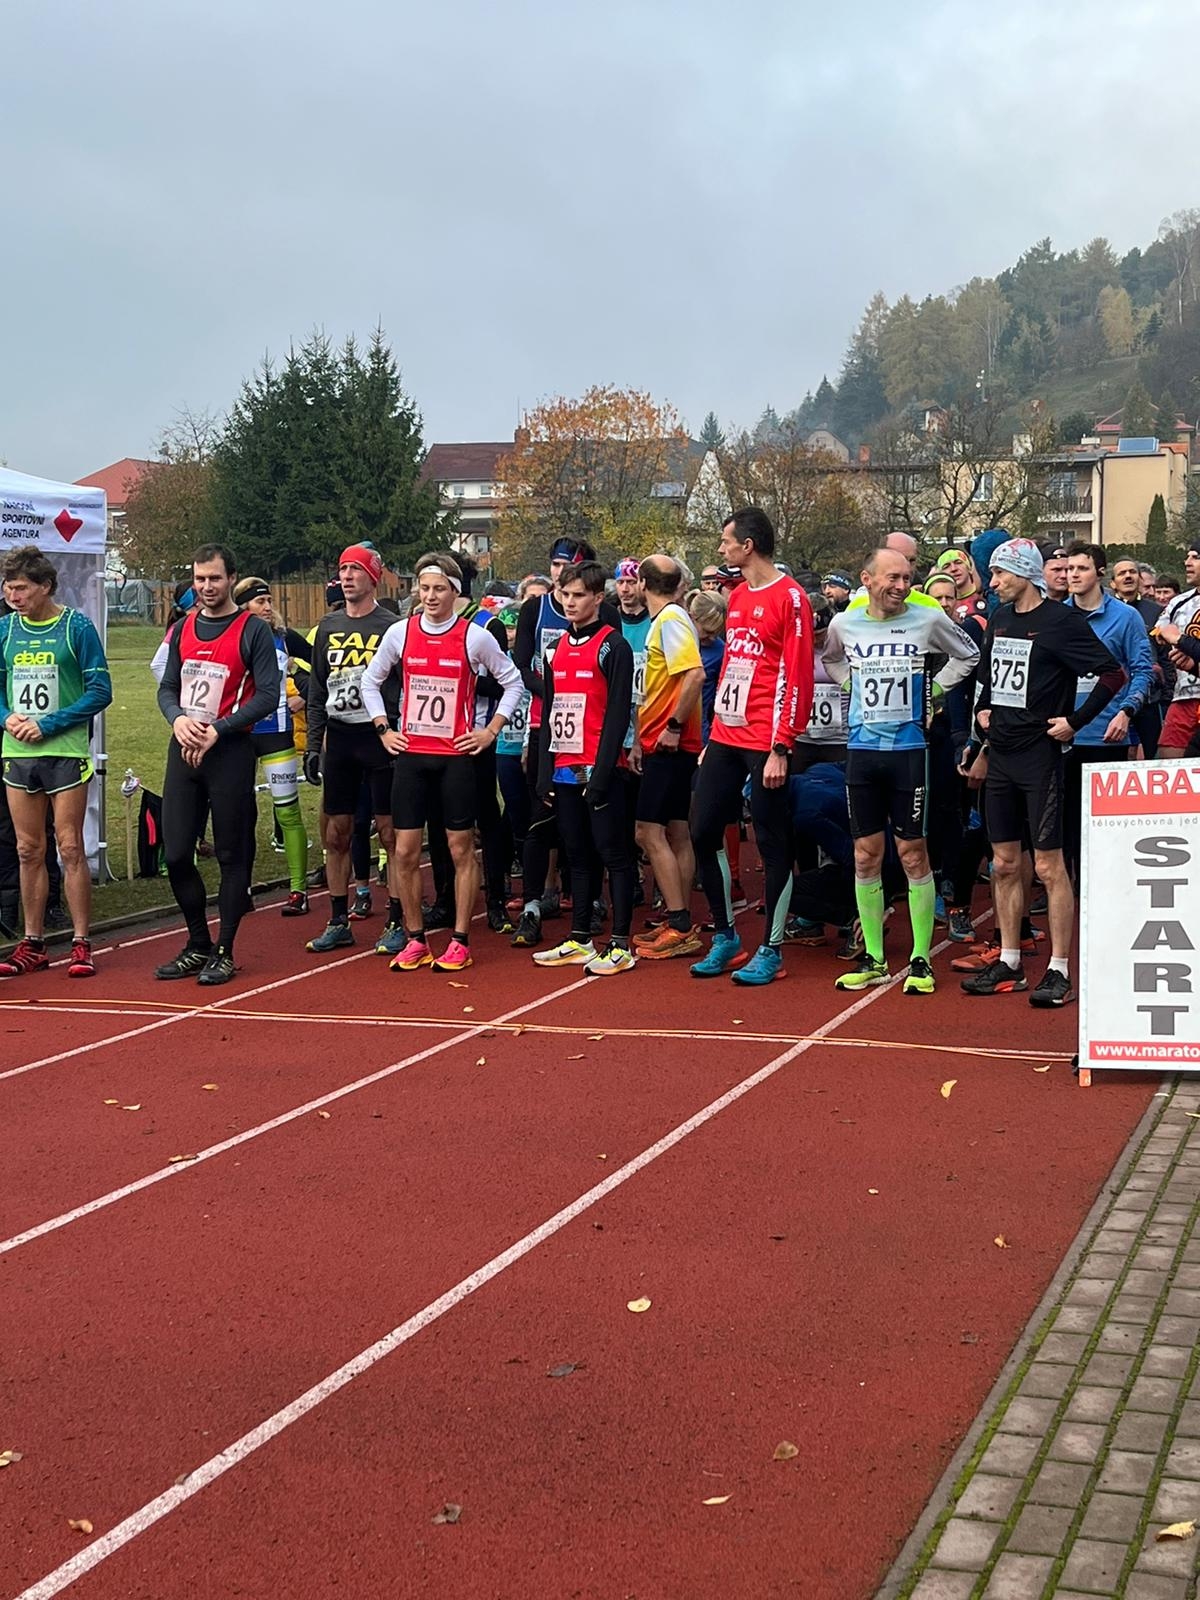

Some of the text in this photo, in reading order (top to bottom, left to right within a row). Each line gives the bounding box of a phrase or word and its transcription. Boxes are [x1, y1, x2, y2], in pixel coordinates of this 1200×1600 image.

[2, 513, 46, 525] SPORTOVNÍ
[2, 528, 40, 539] AGENTURA
[853, 642, 919, 658] ASTER
[208, 671, 224, 679] LIGA
[410, 683, 437, 692] BĚŽECKÁ
[992, 657, 1026, 691] 375
[18, 683, 50, 711] 46
[189, 680, 211, 708] 12
[333, 685, 362, 712] 53
[721, 683, 740, 712] 41
[864, 676, 908, 708] 371
[416, 694, 446, 723] 70
[809, 700, 833, 726] 49
[554, 712, 576, 739] 55
[1092, 818, 1174, 829] tělovýchovná
[1130, 836, 1196, 1036] START
